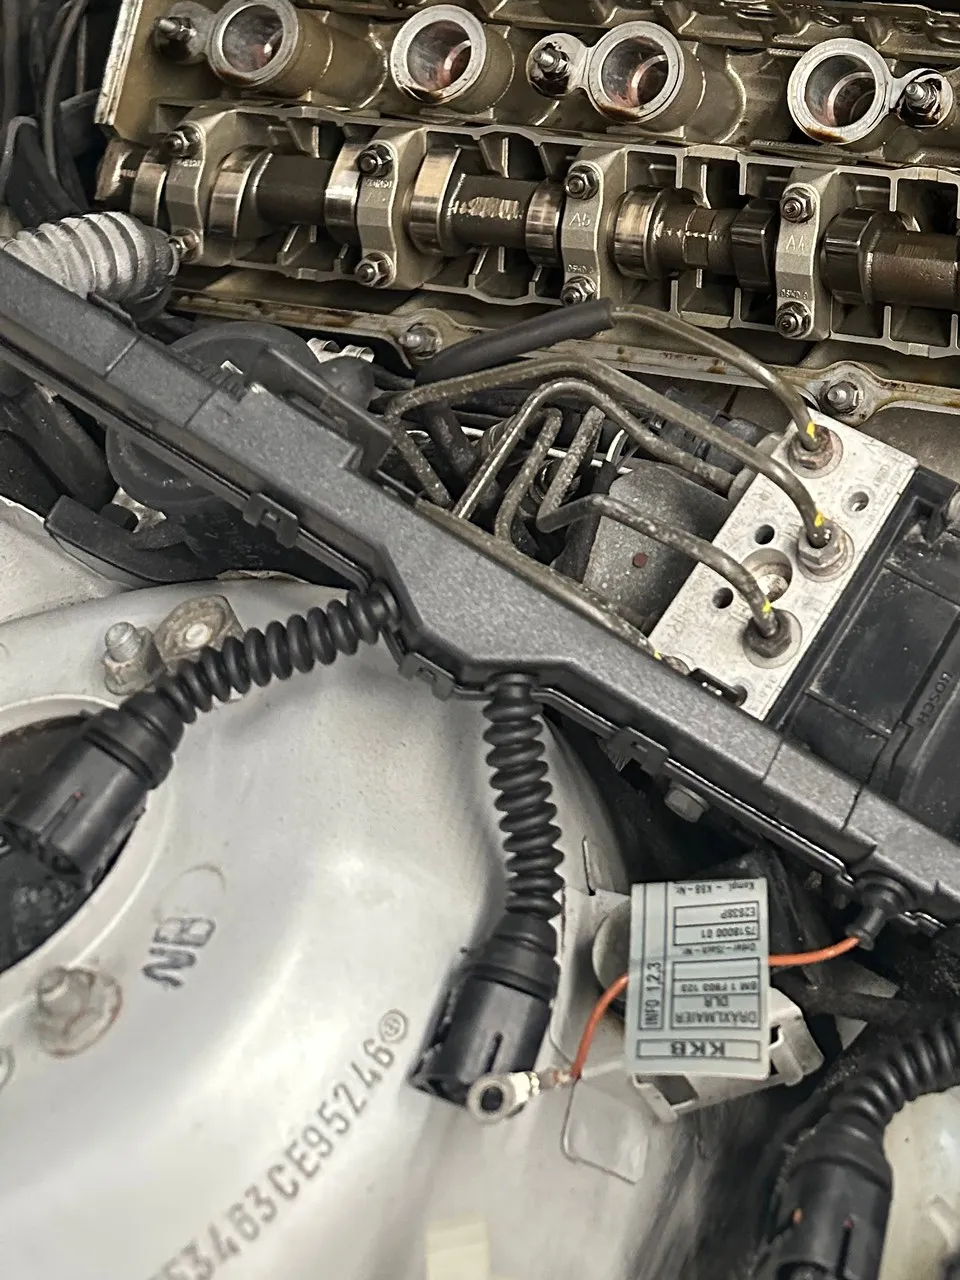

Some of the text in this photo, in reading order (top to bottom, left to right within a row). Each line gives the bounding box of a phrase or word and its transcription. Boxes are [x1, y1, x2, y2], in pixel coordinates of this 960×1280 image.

[785, 234, 806, 252] A4
[644, 999, 660, 1026] INFO
[670, 1040, 726, 1057] KKB
